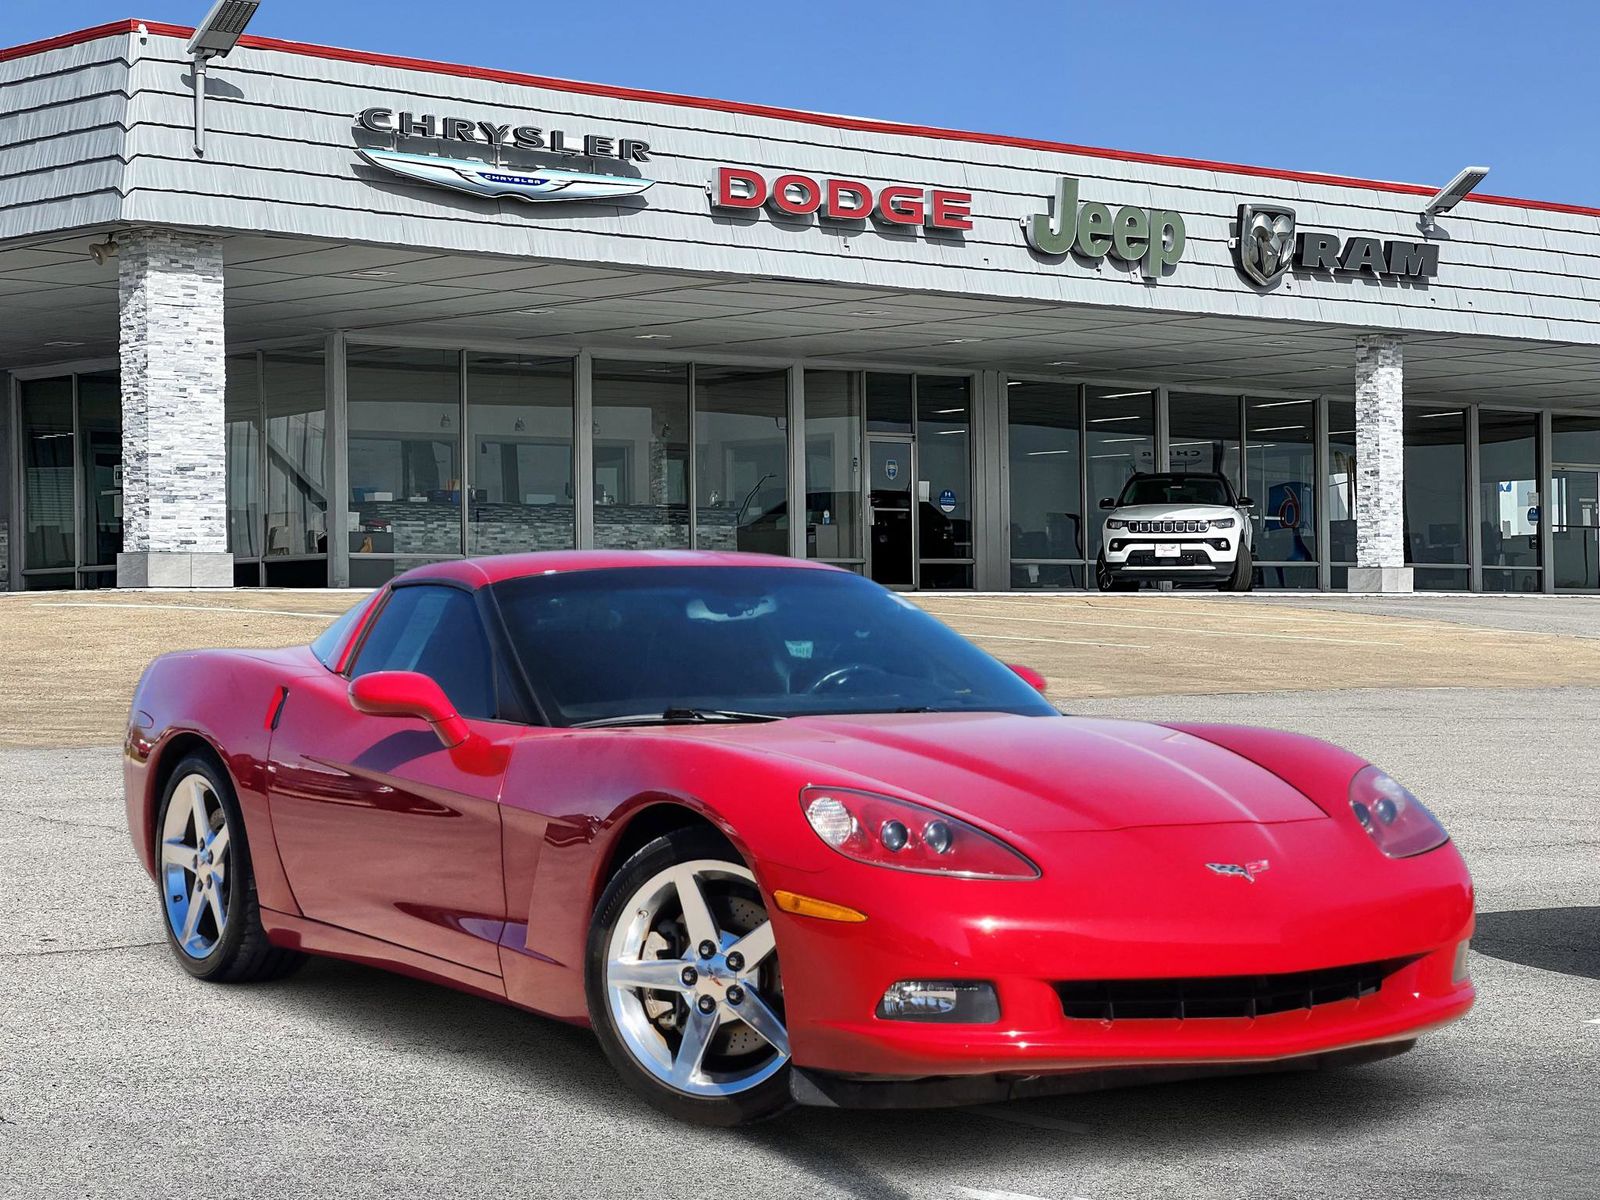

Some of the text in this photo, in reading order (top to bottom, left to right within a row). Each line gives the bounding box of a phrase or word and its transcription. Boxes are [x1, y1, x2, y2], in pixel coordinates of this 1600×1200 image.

[357, 107, 651, 162] CHRYSLER
[484, 174, 541, 185] CHRYSLER
[712, 167, 973, 230] DODGE
[1027, 177, 1186, 278] Jeep
[1296, 232, 1440, 277] RAM
